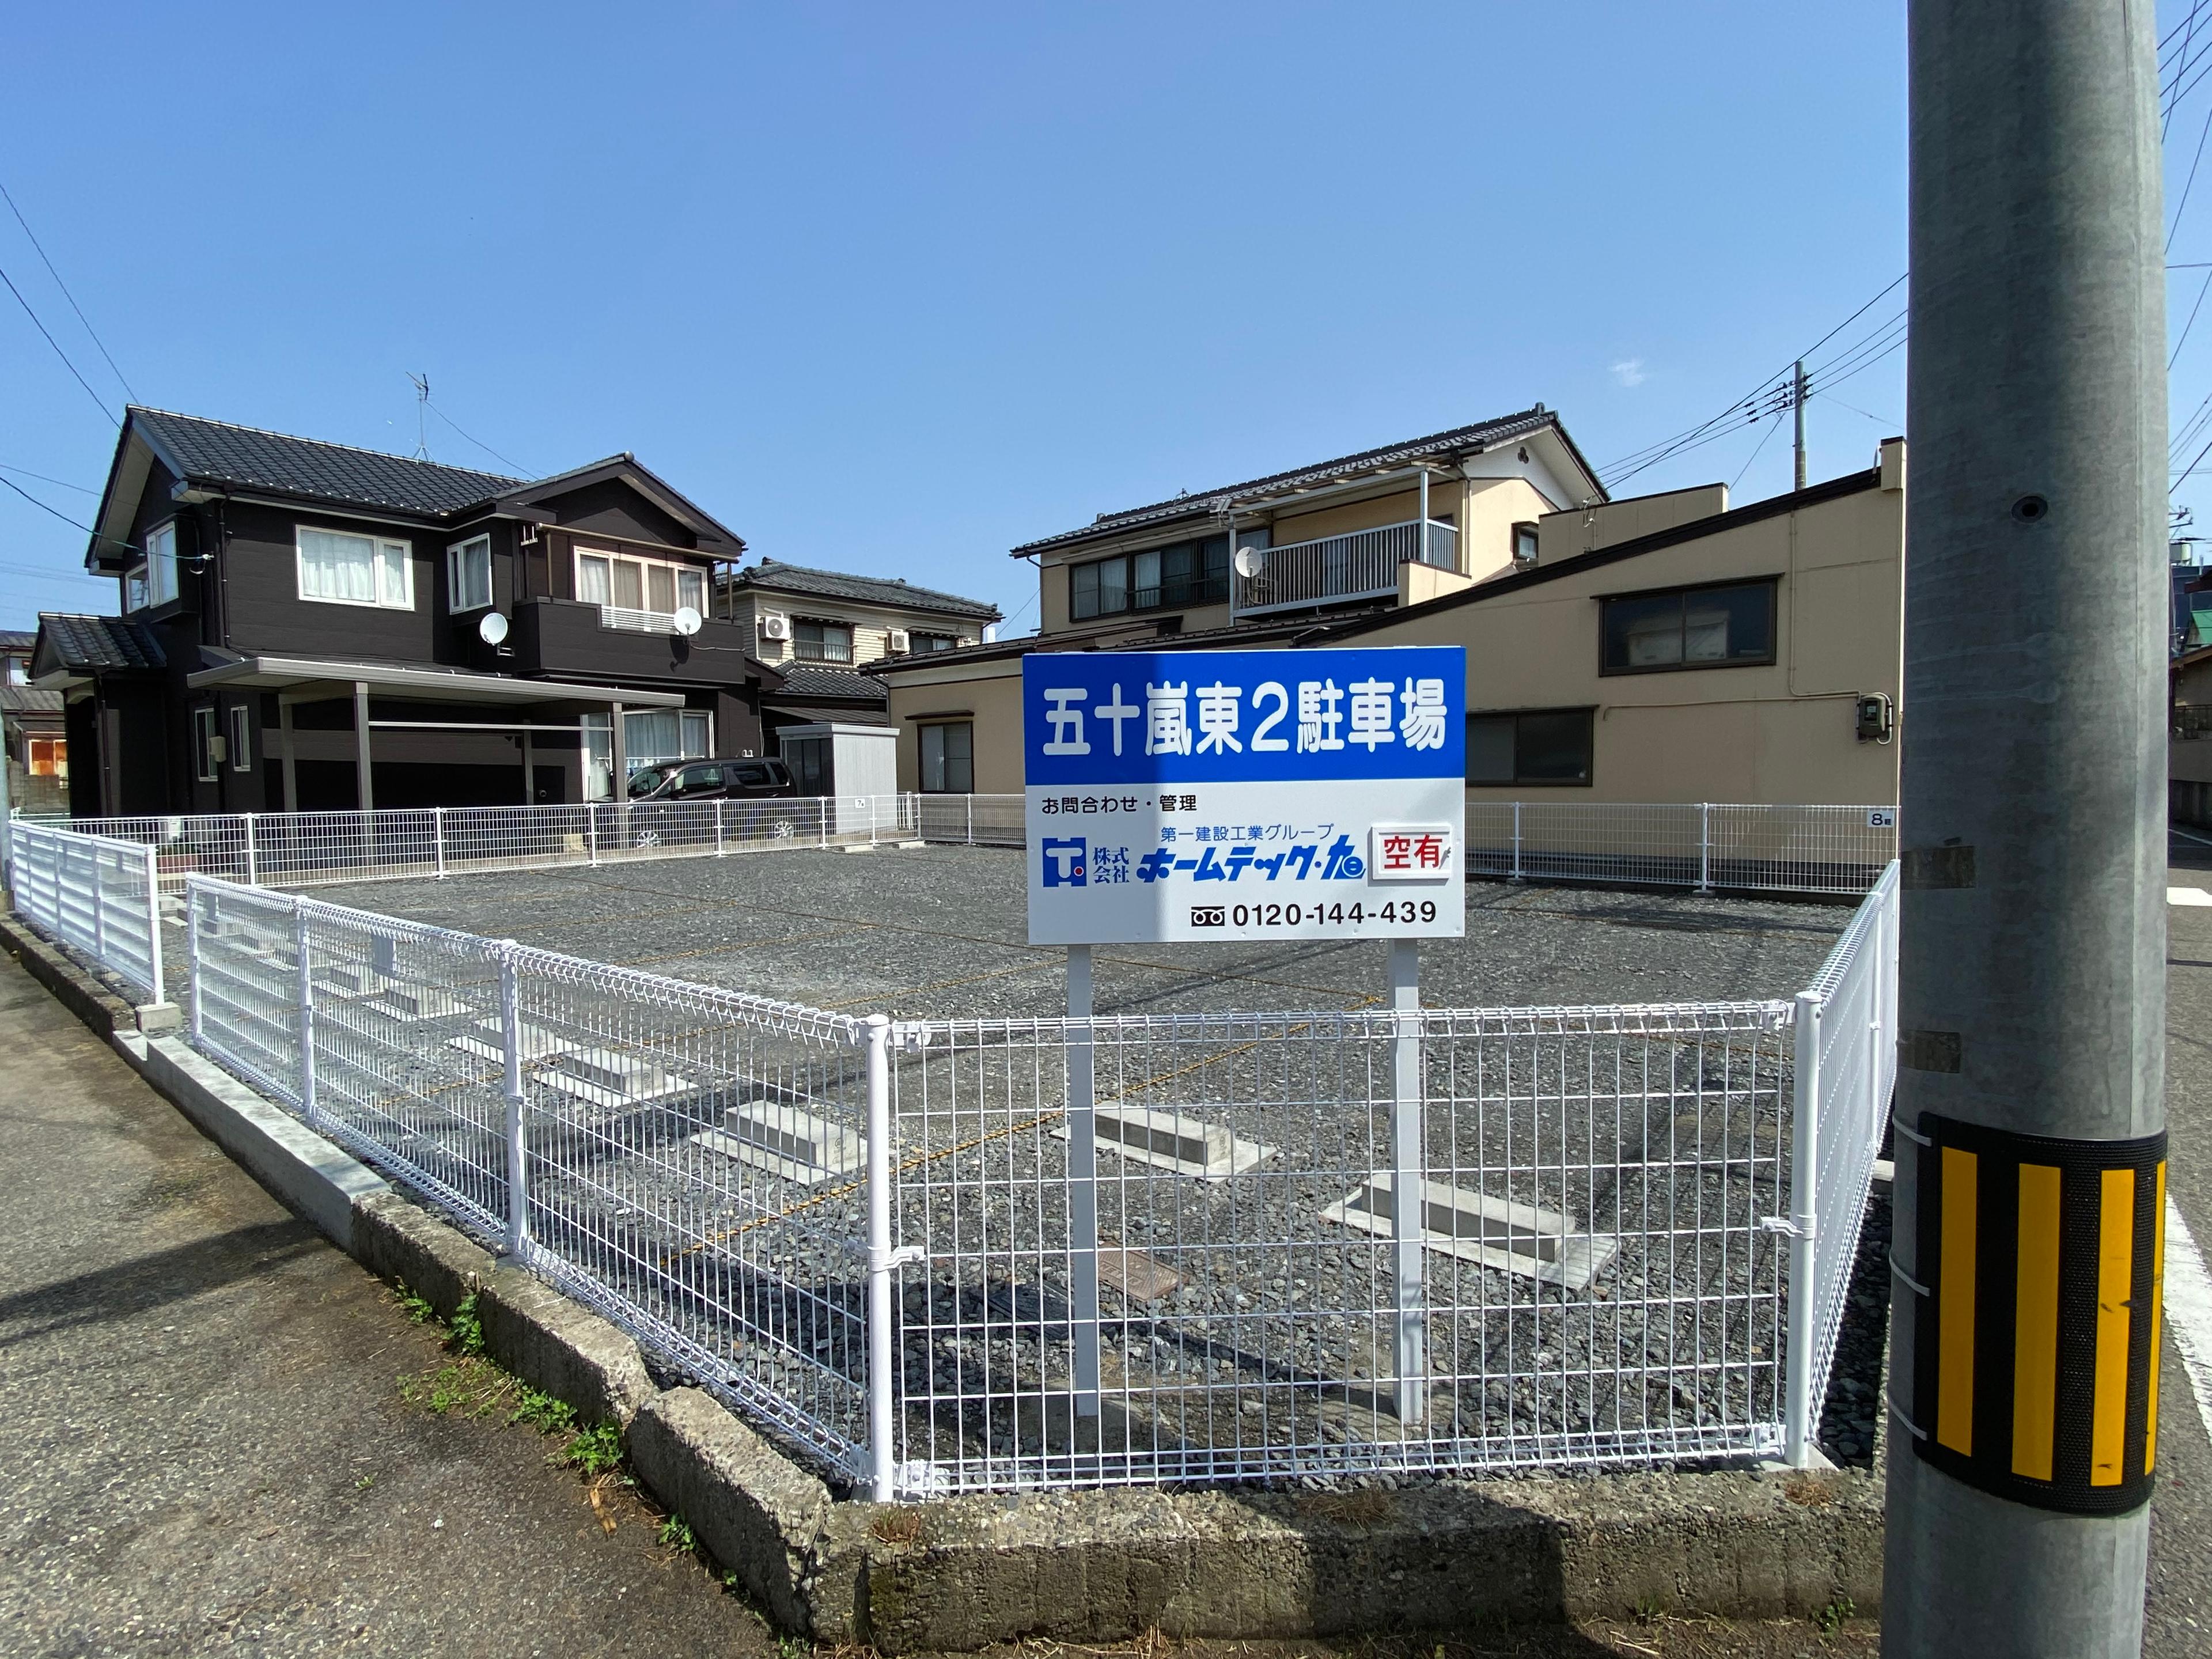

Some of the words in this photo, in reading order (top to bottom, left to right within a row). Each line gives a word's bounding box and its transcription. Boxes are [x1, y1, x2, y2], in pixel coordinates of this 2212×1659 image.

[1043, 677, 1447, 756] 五十嵐東2駐車場
[1041, 794, 1197, 815] お問合わせ・管理
[1160, 824, 1334, 842] 第一建設工業グループ
[1092, 847, 1130, 865] 株式
[1384, 835, 1443, 869] 空有
[1093, 865, 1130, 884] 会社
[1233, 901, 1436, 926] 0120-144-439
